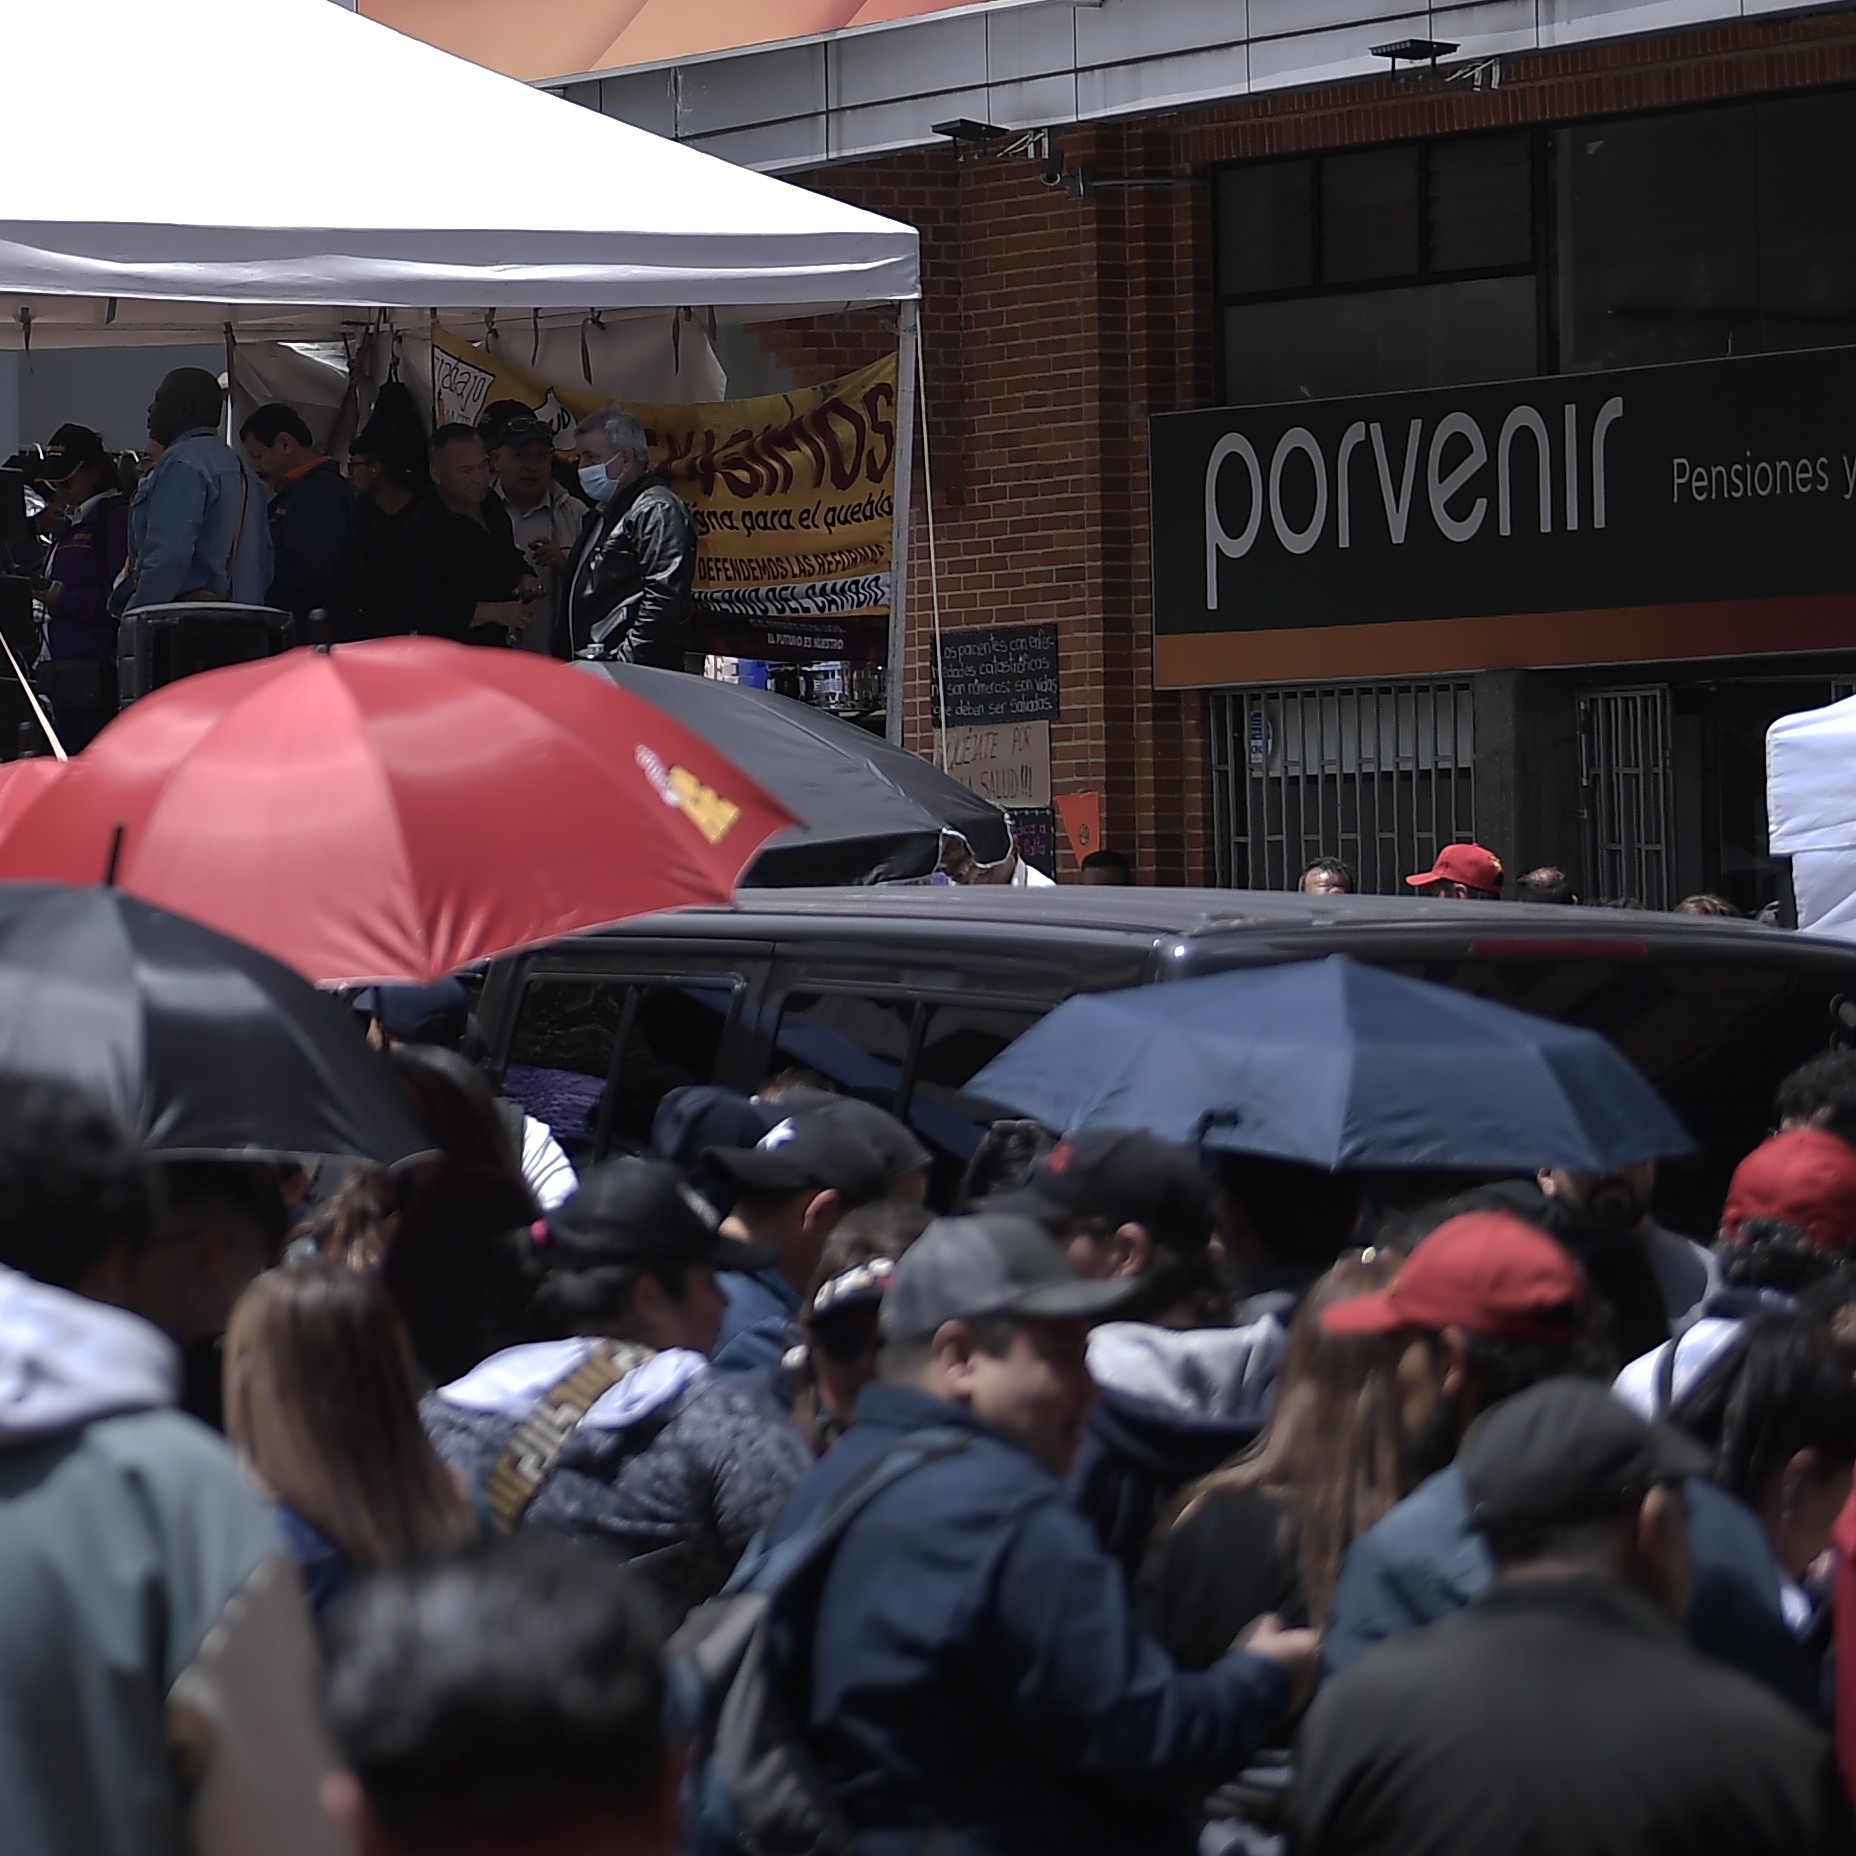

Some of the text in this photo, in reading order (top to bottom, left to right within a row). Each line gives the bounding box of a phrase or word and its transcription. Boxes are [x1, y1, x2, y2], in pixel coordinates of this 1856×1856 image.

[741, 504, 796, 538] para
[799, 499, 823, 530] el
[824, 490, 893, 534] pueblo
[1205, 396, 1856, 610] porvenir Pensiones y
[698, 555, 789, 582] DEFENDEMOS
[790, 555, 816, 578] LAS
[768, 585, 810, 615] DEL
[805, 575, 886, 614] CAMBIO
